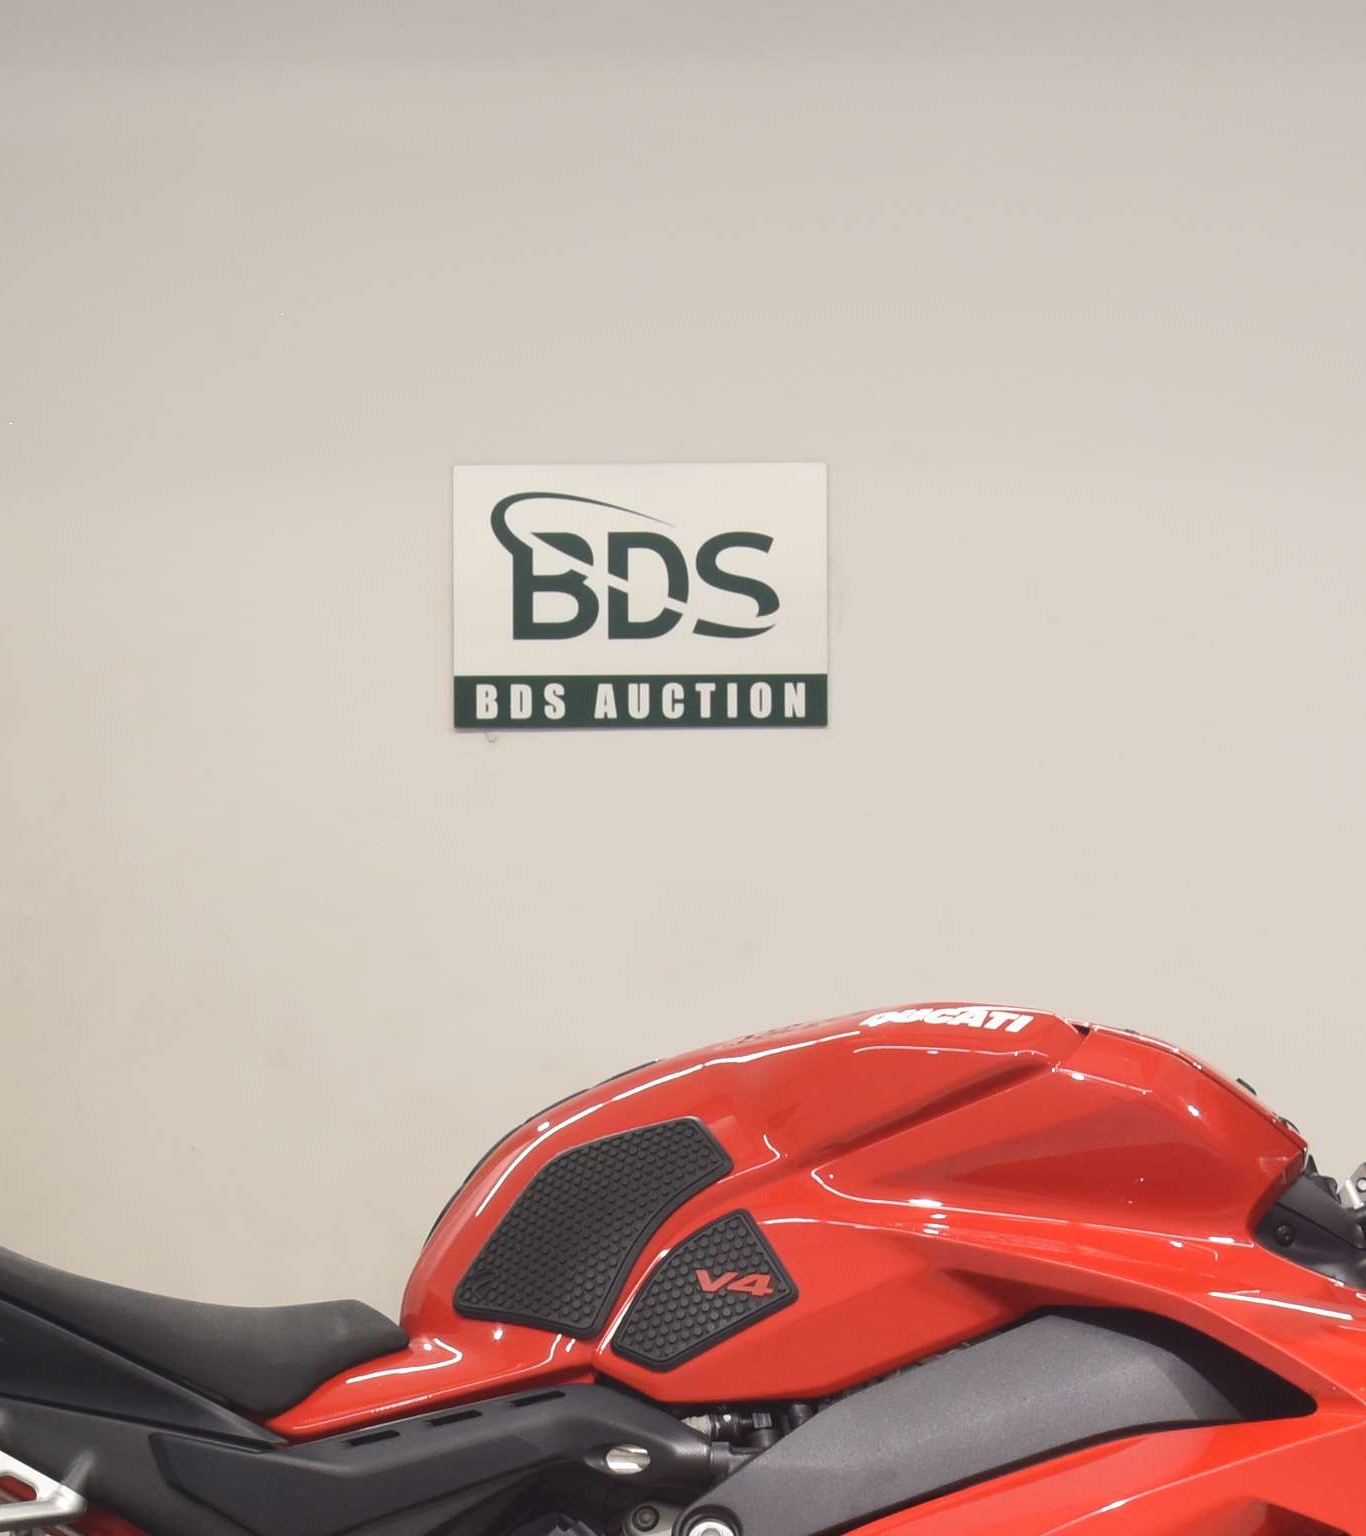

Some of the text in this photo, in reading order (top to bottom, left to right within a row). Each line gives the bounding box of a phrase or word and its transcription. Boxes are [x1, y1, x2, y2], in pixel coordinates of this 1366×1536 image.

[490, 491, 781, 640] BDS
[475, 682, 806, 720] BDS AUCTION
[859, 1006, 1035, 1033] DUCATI
[695, 1269, 774, 1296] V4
